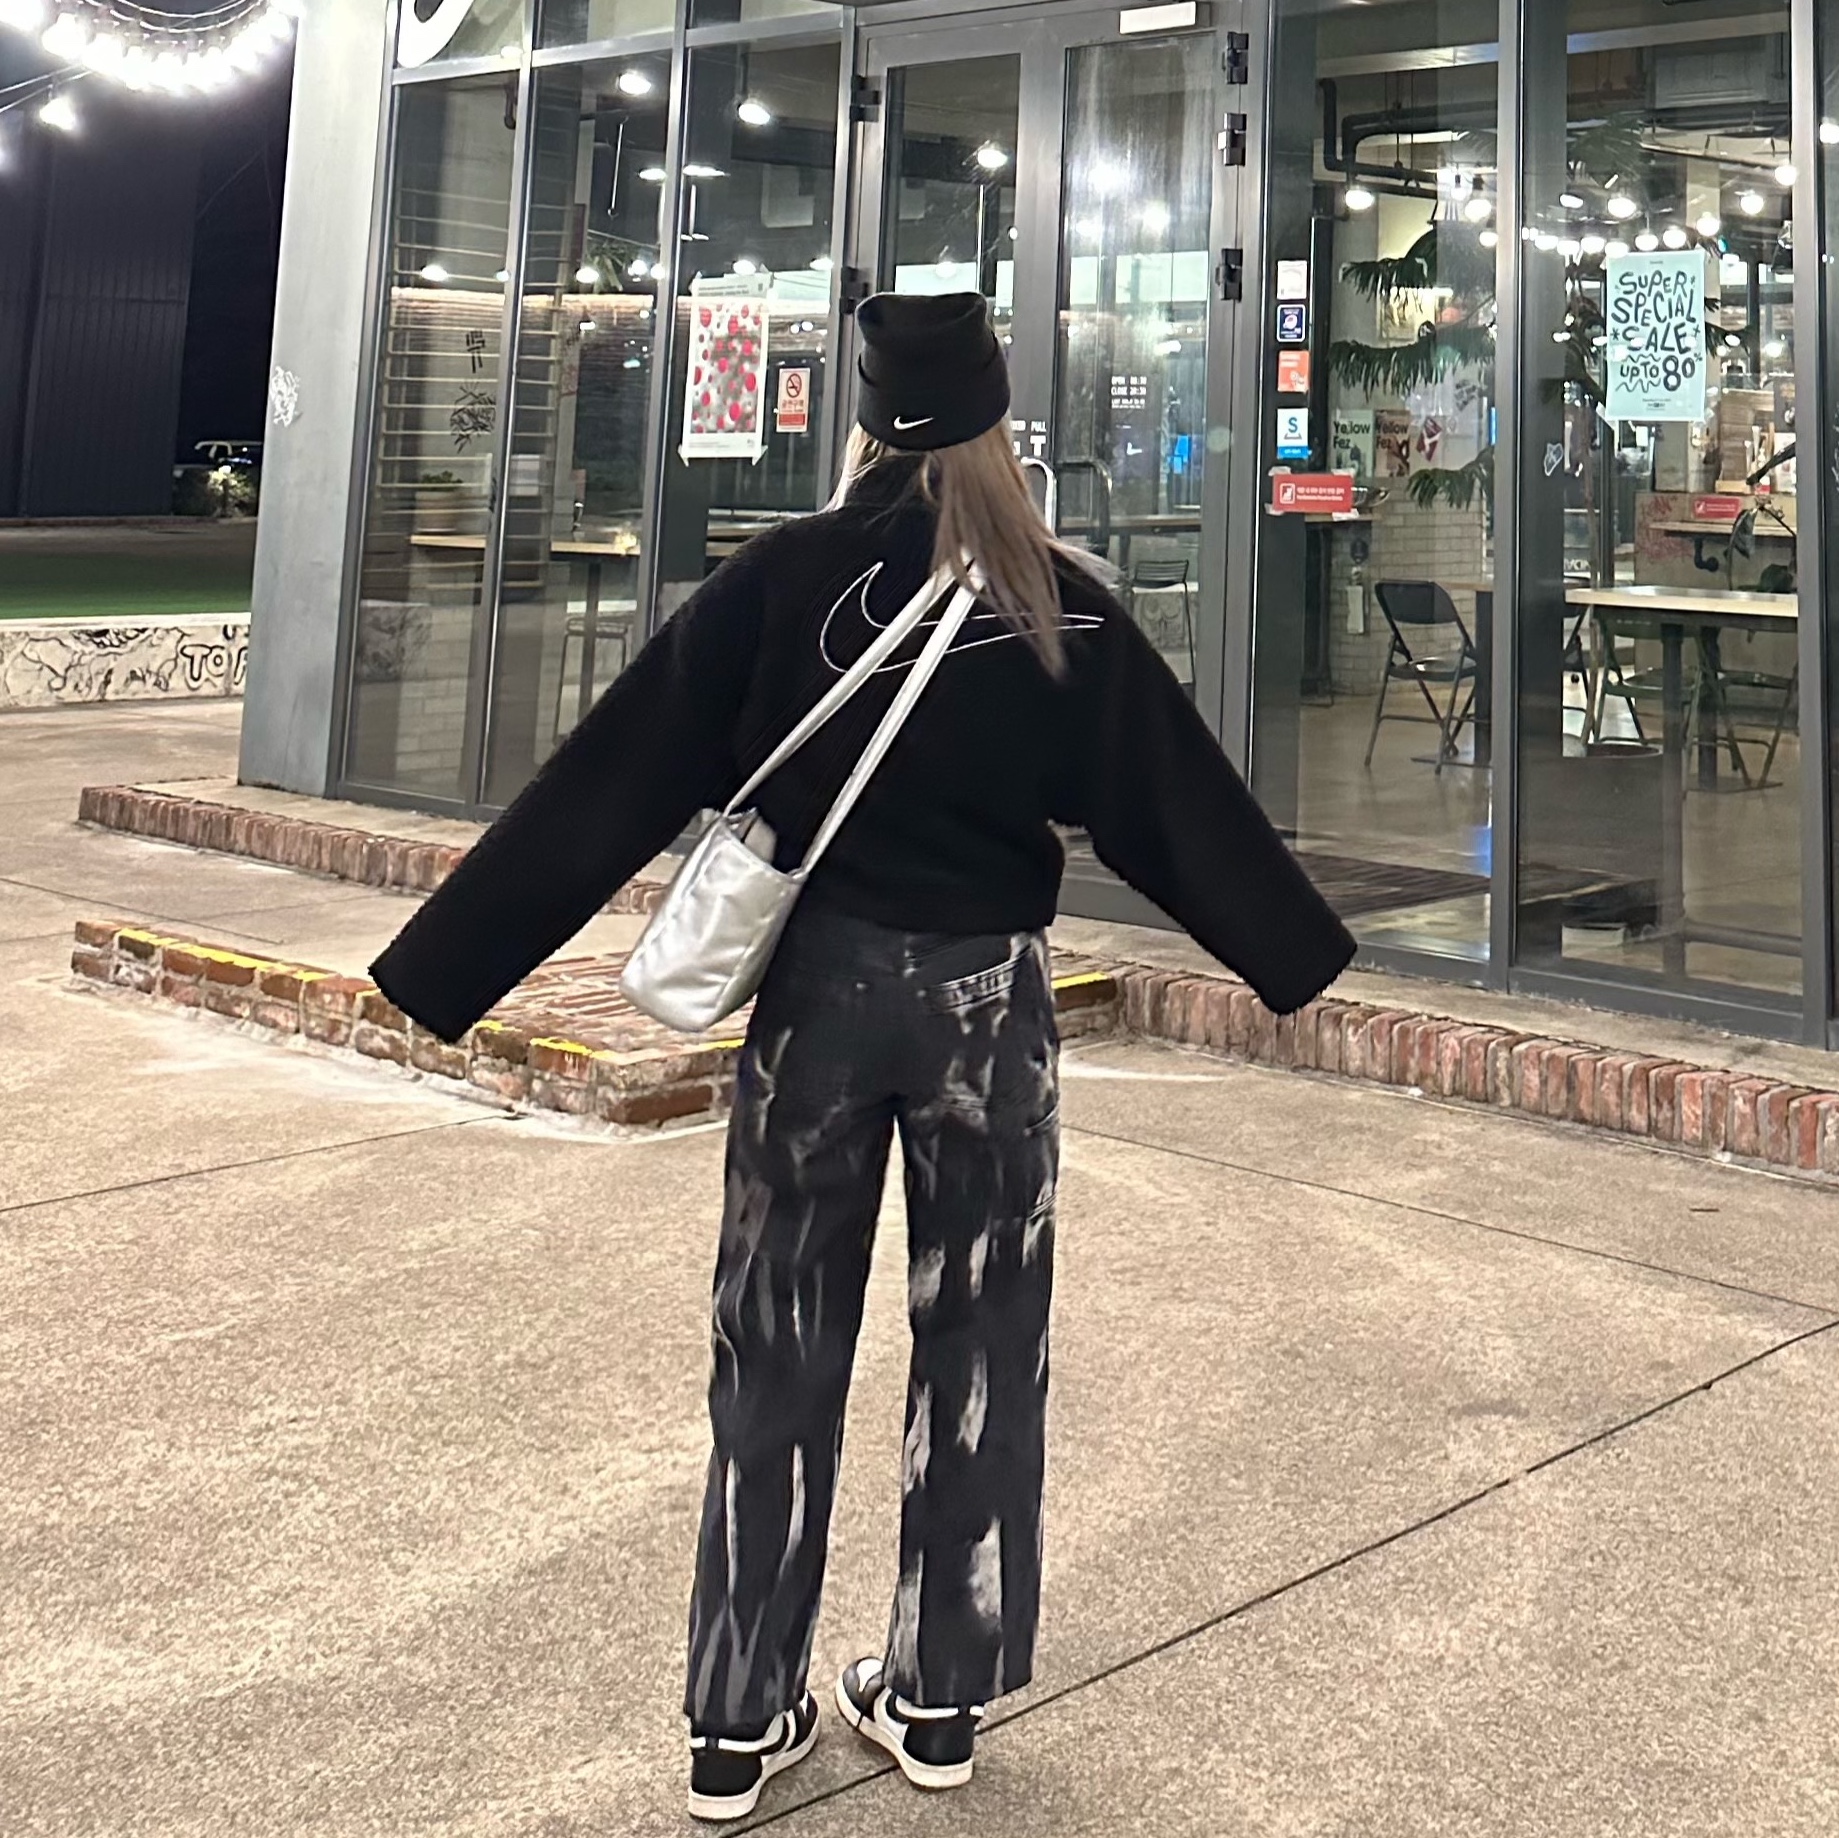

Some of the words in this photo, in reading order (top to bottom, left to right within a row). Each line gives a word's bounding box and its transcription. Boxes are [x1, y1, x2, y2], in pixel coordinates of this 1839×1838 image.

[1619, 270, 1688, 298] SUPER
[1611, 289, 1696, 326] SPECIAL
[1622, 322, 1692, 355] SALE
[1333, 435, 1351, 449] Fez
